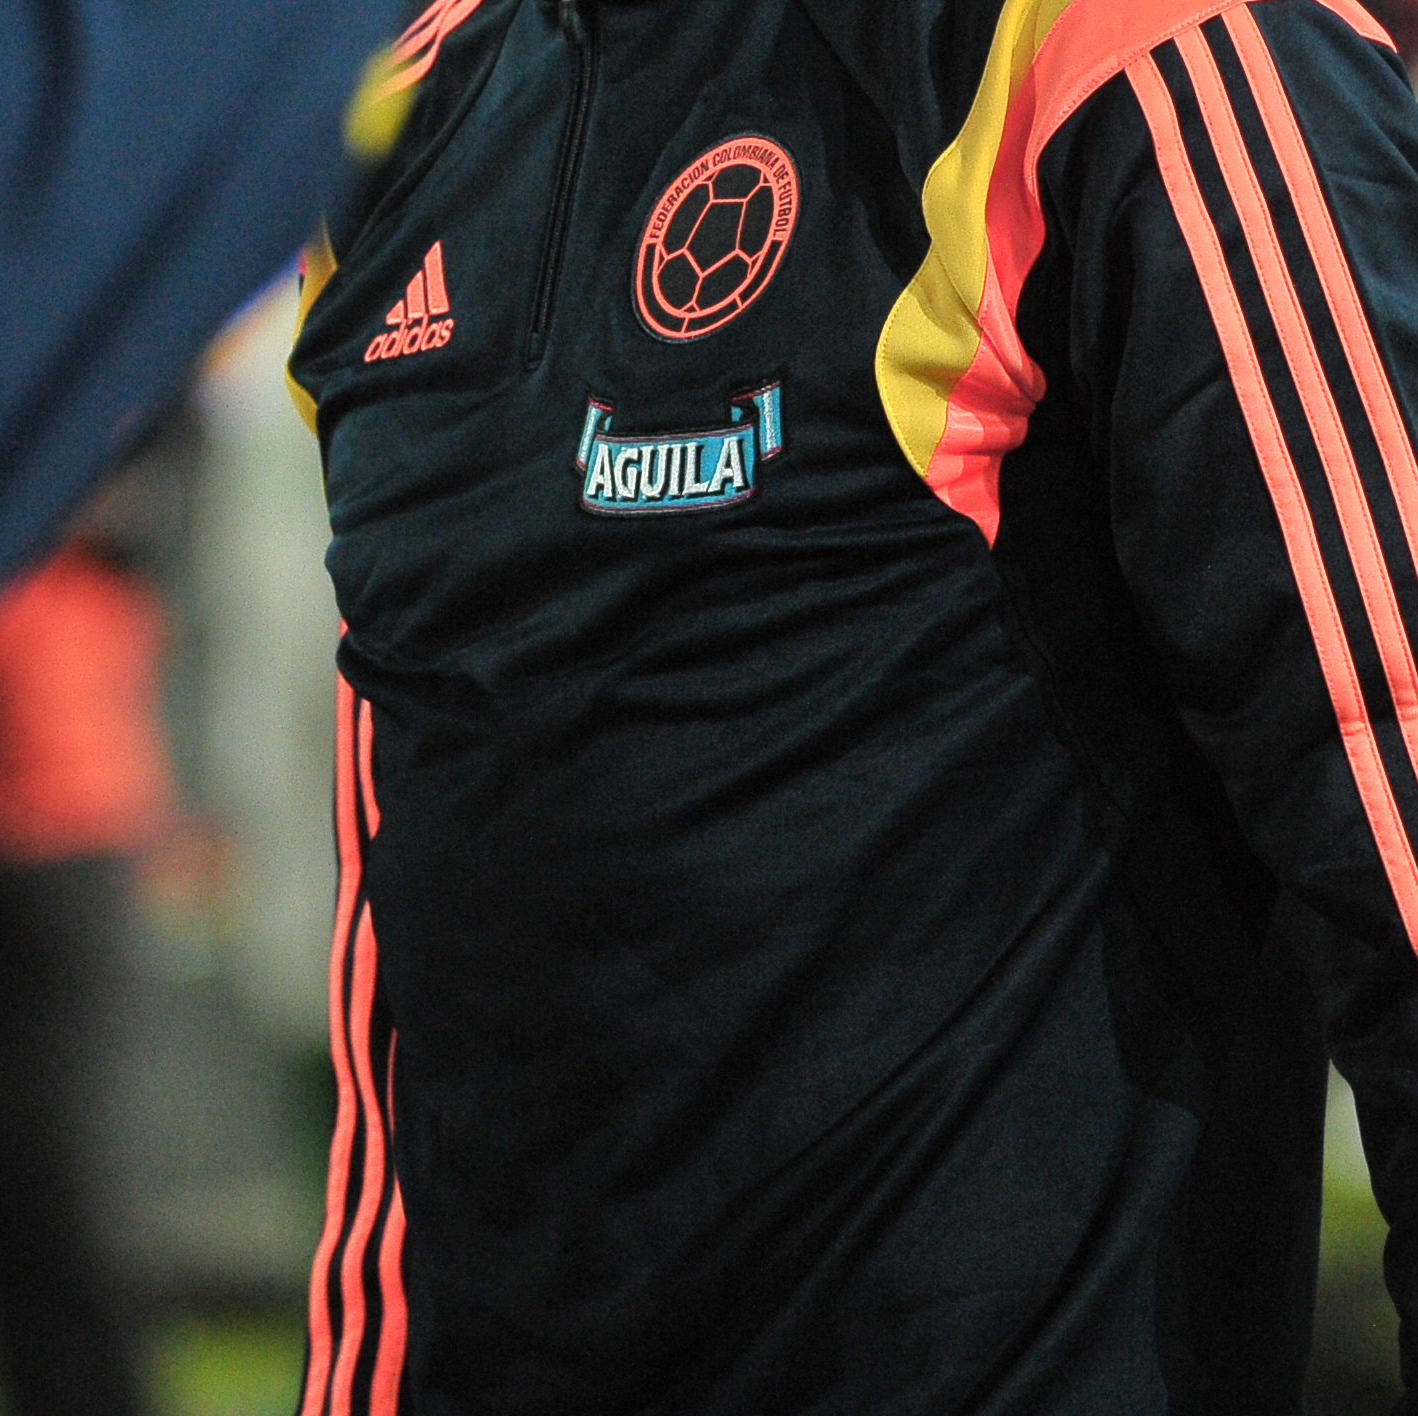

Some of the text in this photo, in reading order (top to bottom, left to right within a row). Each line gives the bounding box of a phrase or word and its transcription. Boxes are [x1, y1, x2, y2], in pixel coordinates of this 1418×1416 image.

[649, 145, 792, 239] FEDERACION COLOMBIANA DE FUTBOL
[364, 316, 454, 362] adidas
[587, 436, 749, 500] AGUILA
